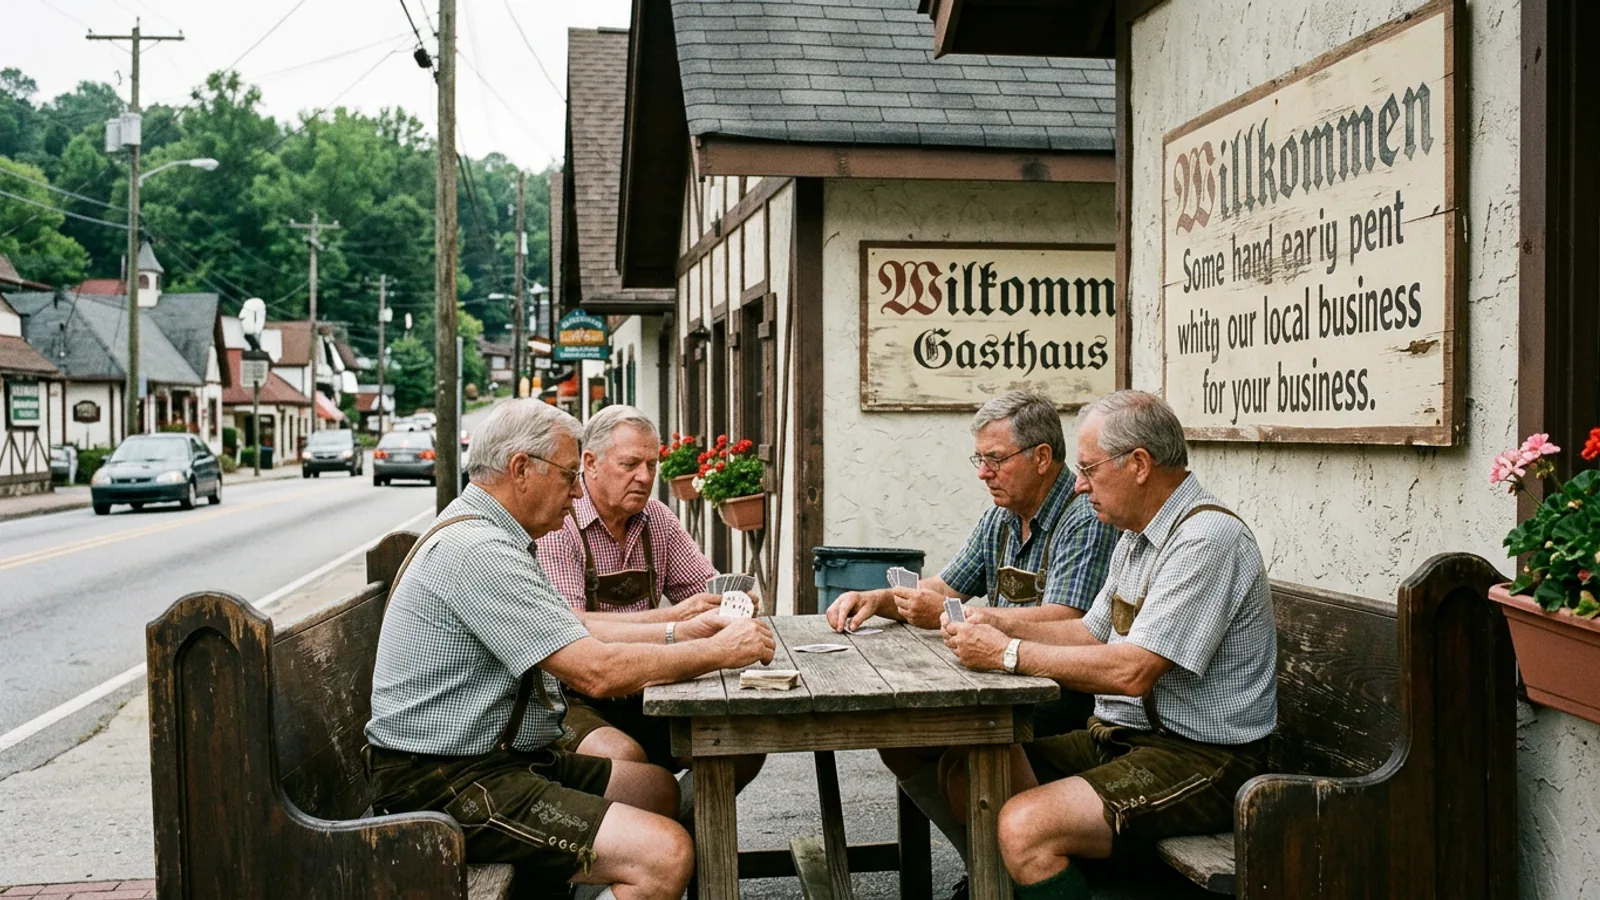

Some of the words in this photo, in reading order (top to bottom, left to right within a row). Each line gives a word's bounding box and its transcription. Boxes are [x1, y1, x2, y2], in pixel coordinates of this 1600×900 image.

[1174, 82, 1434, 236] Willkommen
[1183, 248, 1225, 294] Some
[1350, 190, 1404, 266] pent
[1228, 311, 1257, 350] our
[1264, 287, 1310, 345] local
[1319, 275, 1422, 339] business
[913, 328, 1108, 377] Gasthaus
[1203, 368, 1226, 415] for
[1230, 377, 1271, 425] your
[1278, 357, 1376, 413] business.
